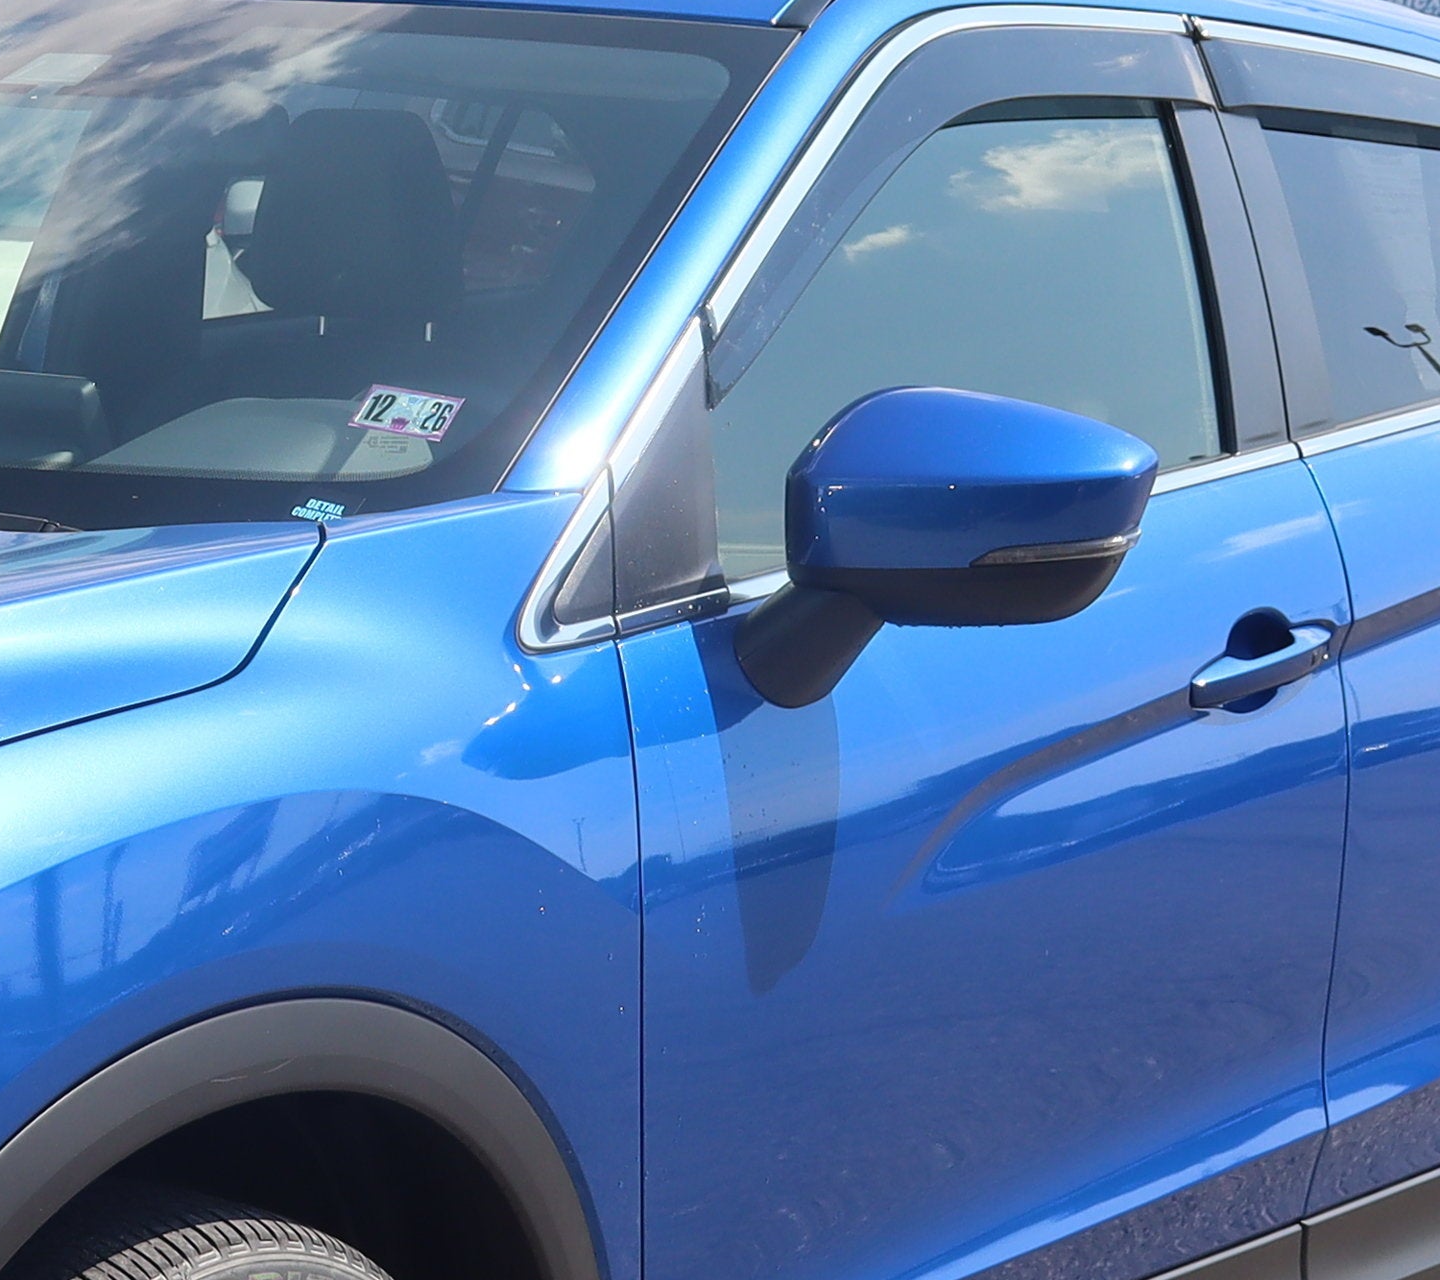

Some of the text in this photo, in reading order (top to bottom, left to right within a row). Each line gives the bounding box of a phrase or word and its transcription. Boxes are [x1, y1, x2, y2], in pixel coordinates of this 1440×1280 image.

[364, 394, 454, 432] 12 26
[305, 498, 345, 516] DETAIL
